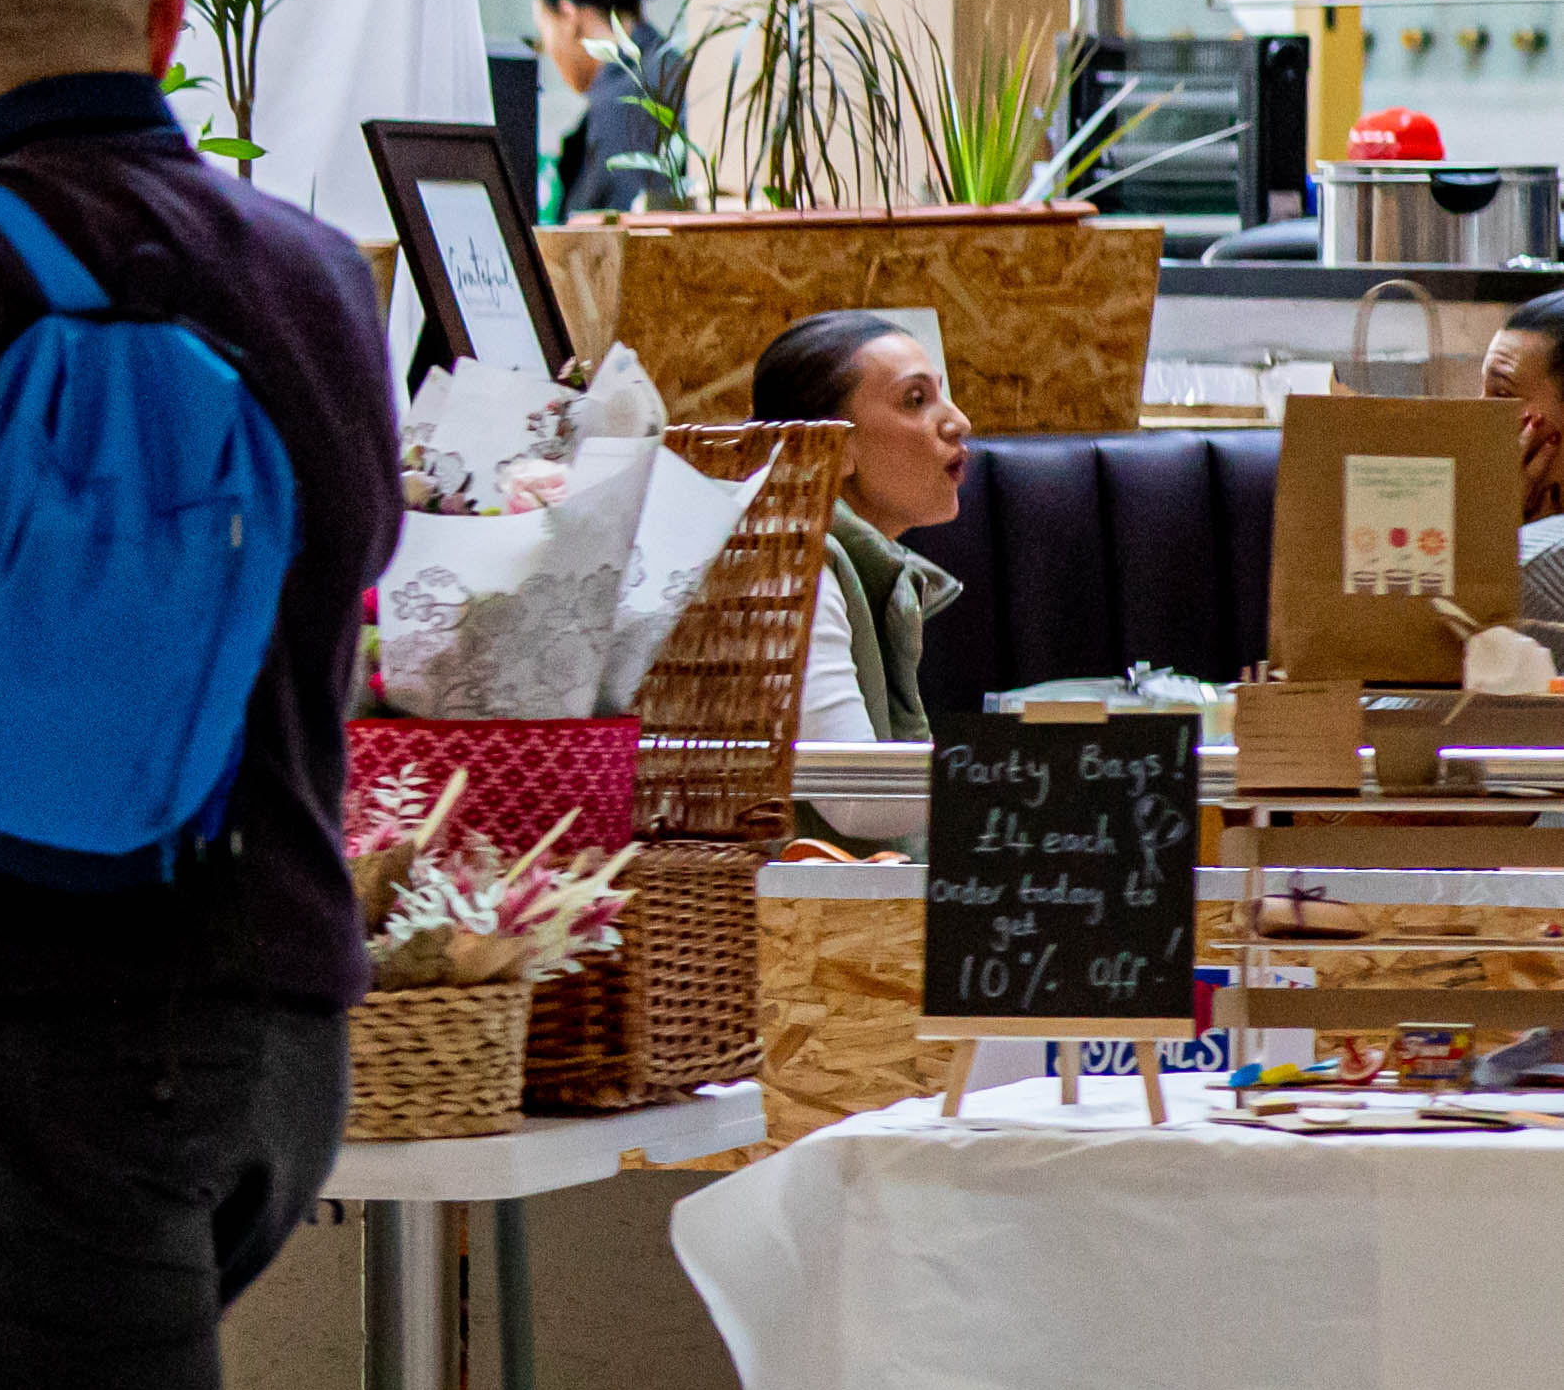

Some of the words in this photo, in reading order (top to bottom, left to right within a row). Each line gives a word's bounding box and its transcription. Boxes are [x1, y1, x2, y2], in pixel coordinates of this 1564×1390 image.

[940, 744, 1051, 807] Party
[972, 807, 1034, 855] £4
[1041, 813, 1118, 855] each
[1017, 872, 1106, 926] today
[1122, 869, 1157, 907] to
[989, 911, 1038, 952] get
